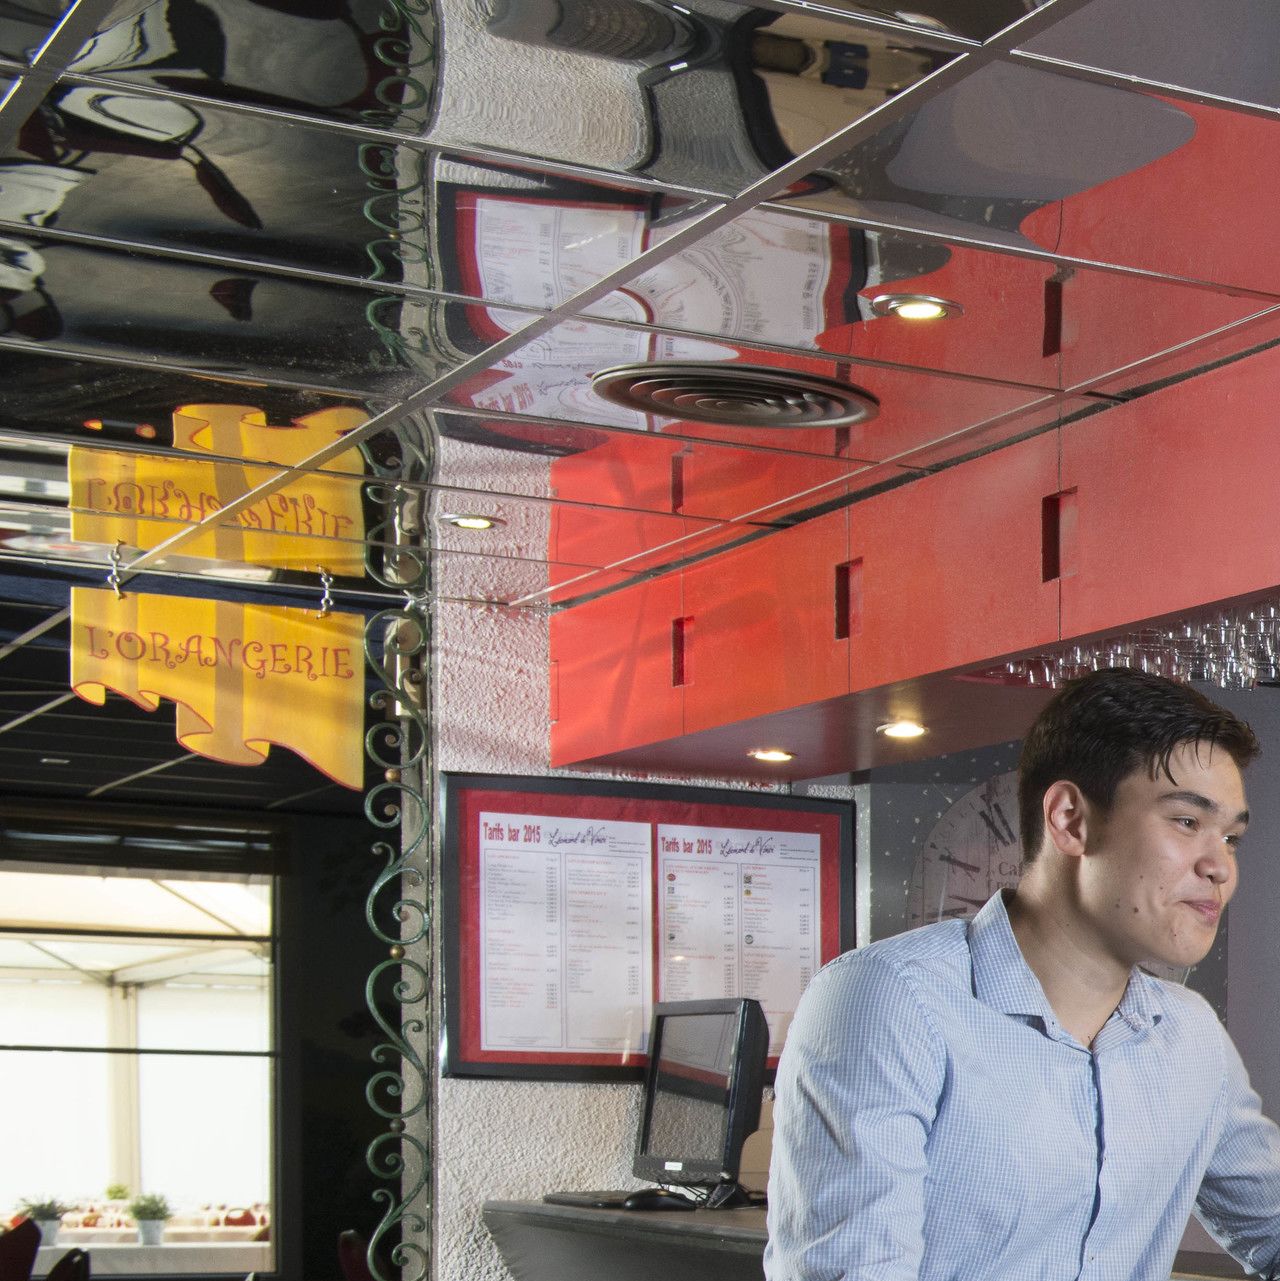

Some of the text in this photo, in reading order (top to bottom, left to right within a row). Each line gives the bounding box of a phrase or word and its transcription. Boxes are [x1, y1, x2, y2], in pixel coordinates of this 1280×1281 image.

[84, 624, 355, 681] L'ORANGERIE
[483, 822, 504, 841] Tarifs
[508, 824, 520, 842] bar
[523, 825, 541, 843] 2015
[661, 837, 679, 854] Tarifs
[683, 838, 694, 854] bar
[697, 838, 712, 855] 2015
